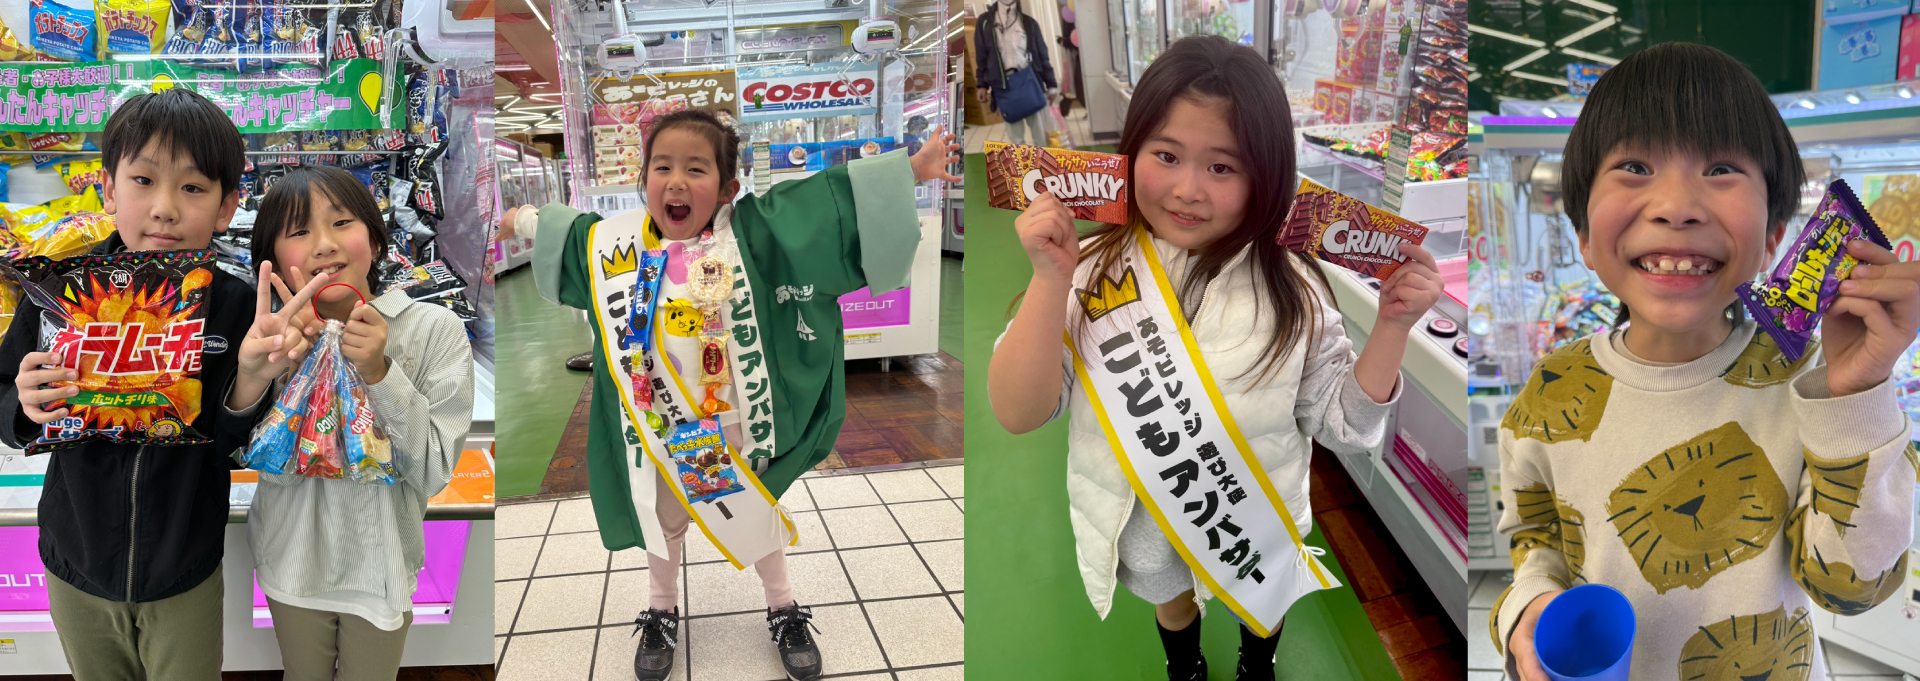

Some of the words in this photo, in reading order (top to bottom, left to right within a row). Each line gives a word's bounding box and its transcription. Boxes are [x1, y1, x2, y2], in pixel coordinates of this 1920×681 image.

[34, 12, 89, 46] ポテトチップス
[102, 9, 158, 40] ポテトチップス
[743, 78, 875, 104] COSTCO
[783, 96, 871, 111] WHOLESALE
[1022, 168, 1124, 202] CRUNKY
[1308, 182, 1326, 193] LOTTE
[1343, 254, 1364, 263] CRUNCH
[1363, 256, 1392, 265] CHOCOLATE
[1786, 217, 1851, 313] ロールキャンディ
[114, 273, 128, 284] 湖
[635, 281, 644, 315] OREO
[91, 393, 157, 405] ホットチリ味
[1196, 441, 1248, 506] 遊び大使
